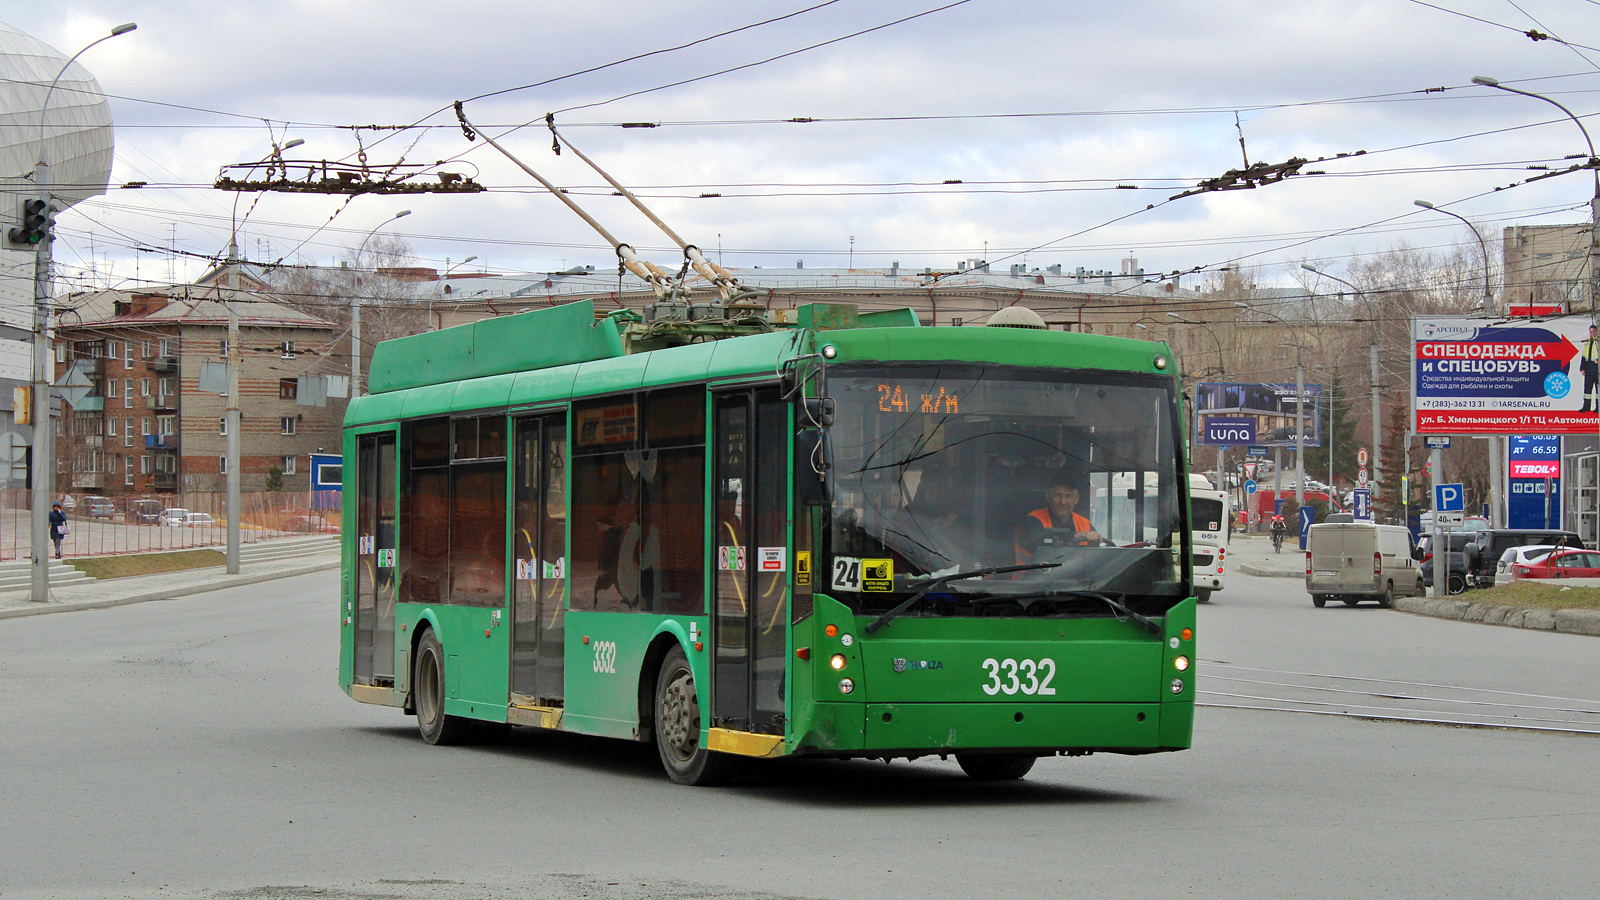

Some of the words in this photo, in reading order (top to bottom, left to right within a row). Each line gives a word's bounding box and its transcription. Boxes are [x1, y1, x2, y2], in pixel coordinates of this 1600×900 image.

[1422, 344, 1546, 359] СПЕЦОДЕЖДА
[1423, 362, 1432, 371] и
[1437, 360, 1540, 374] СПЕЦОБУВЬ
[1432, 400, 1467, 408] (383)-362
[1448, 416, 1518, 424] Хмельницкого
[1520, 416, 1531, 424] 1/1
[1533, 416, 1545, 425] ТЦ
[1532, 446, 1557, 454] 66.59
[1442, 487, 1457, 509] P
[834, 560, 859, 588] 24
[593, 641, 616, 675] 3332
[981, 657, 1056, 696] 3332
